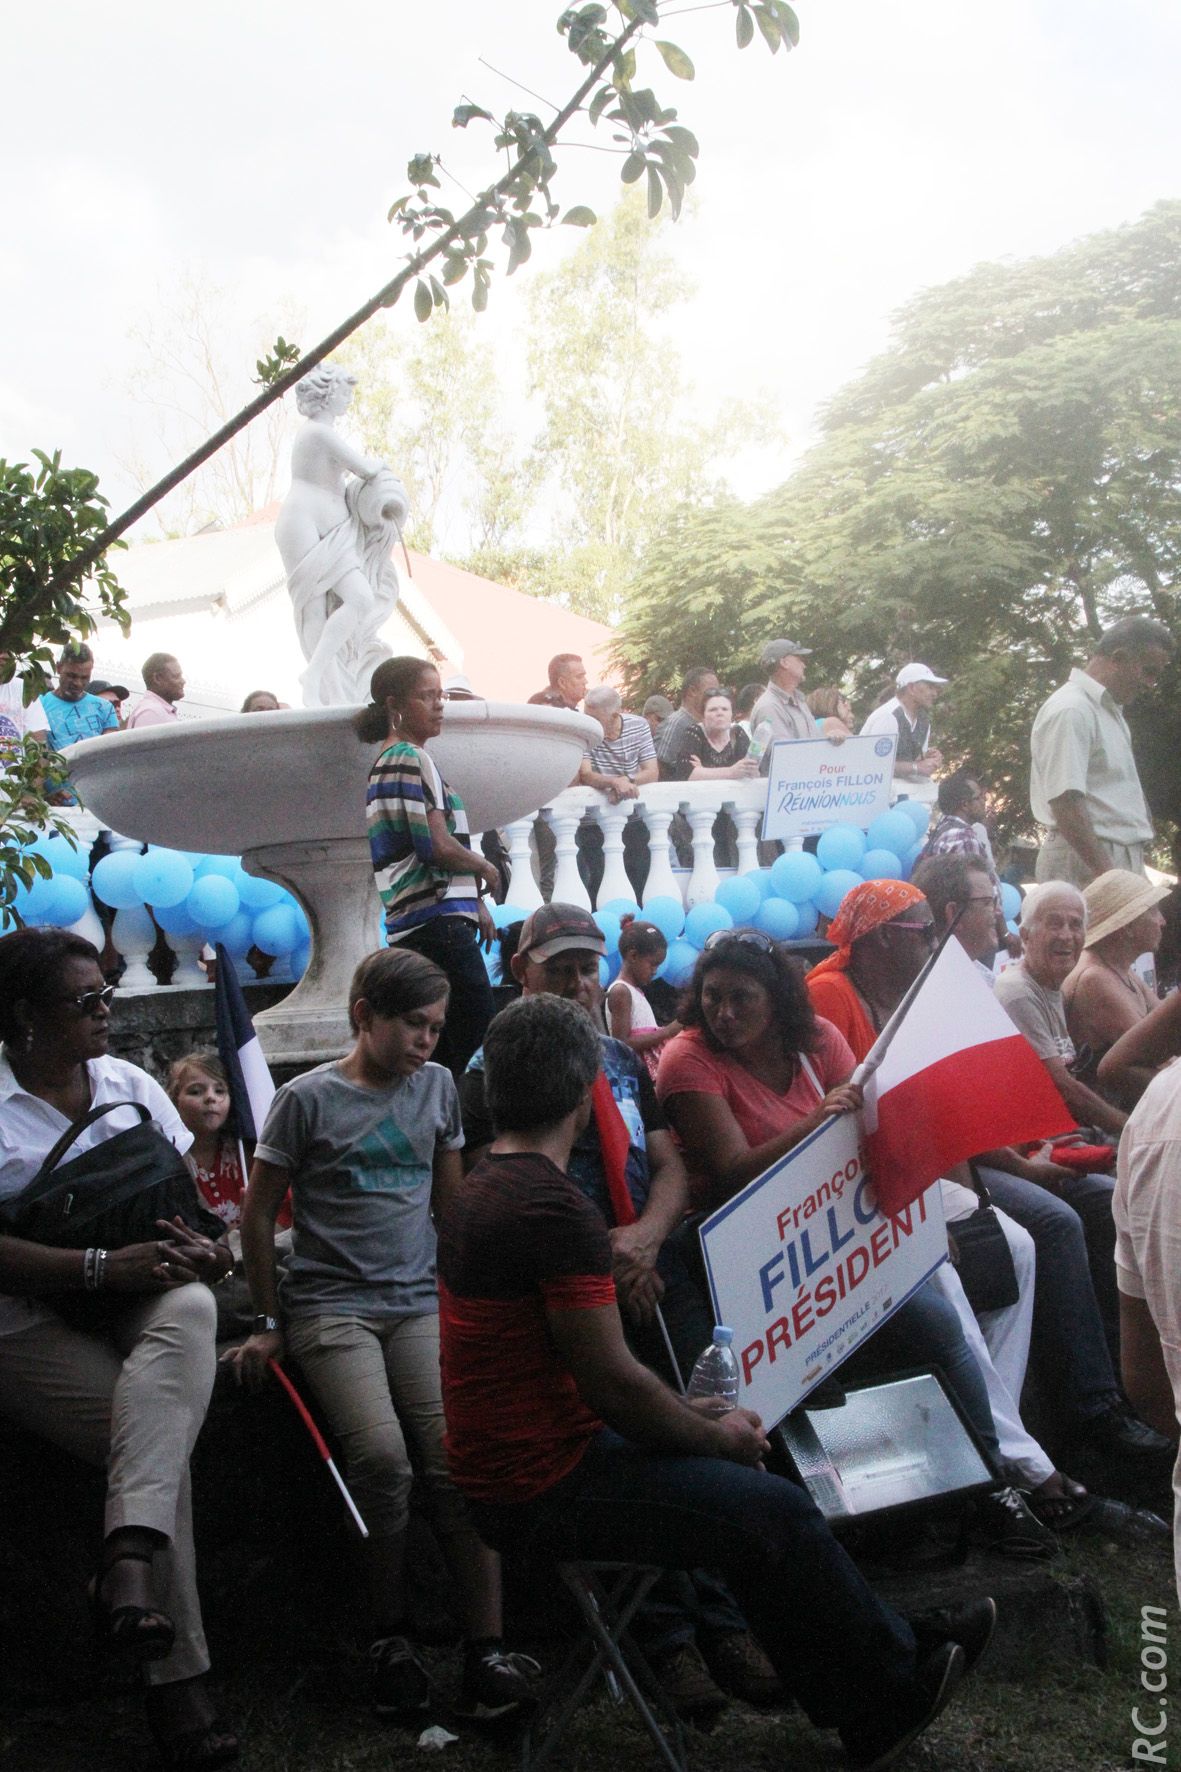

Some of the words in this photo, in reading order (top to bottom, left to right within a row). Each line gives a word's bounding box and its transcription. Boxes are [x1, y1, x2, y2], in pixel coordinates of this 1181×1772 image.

[777, 777, 833, 793] François
[836, 773, 884, 787] FILLON
[819, 764, 846, 775] Pour
[776, 1158, 859, 1241] Franço
[759, 1173, 880, 1314] FILLO
[740, 1189, 927, 1387] PRÉSIDENT
[805, 1301, 871, 1367] PRÉSIDENTIELLE
